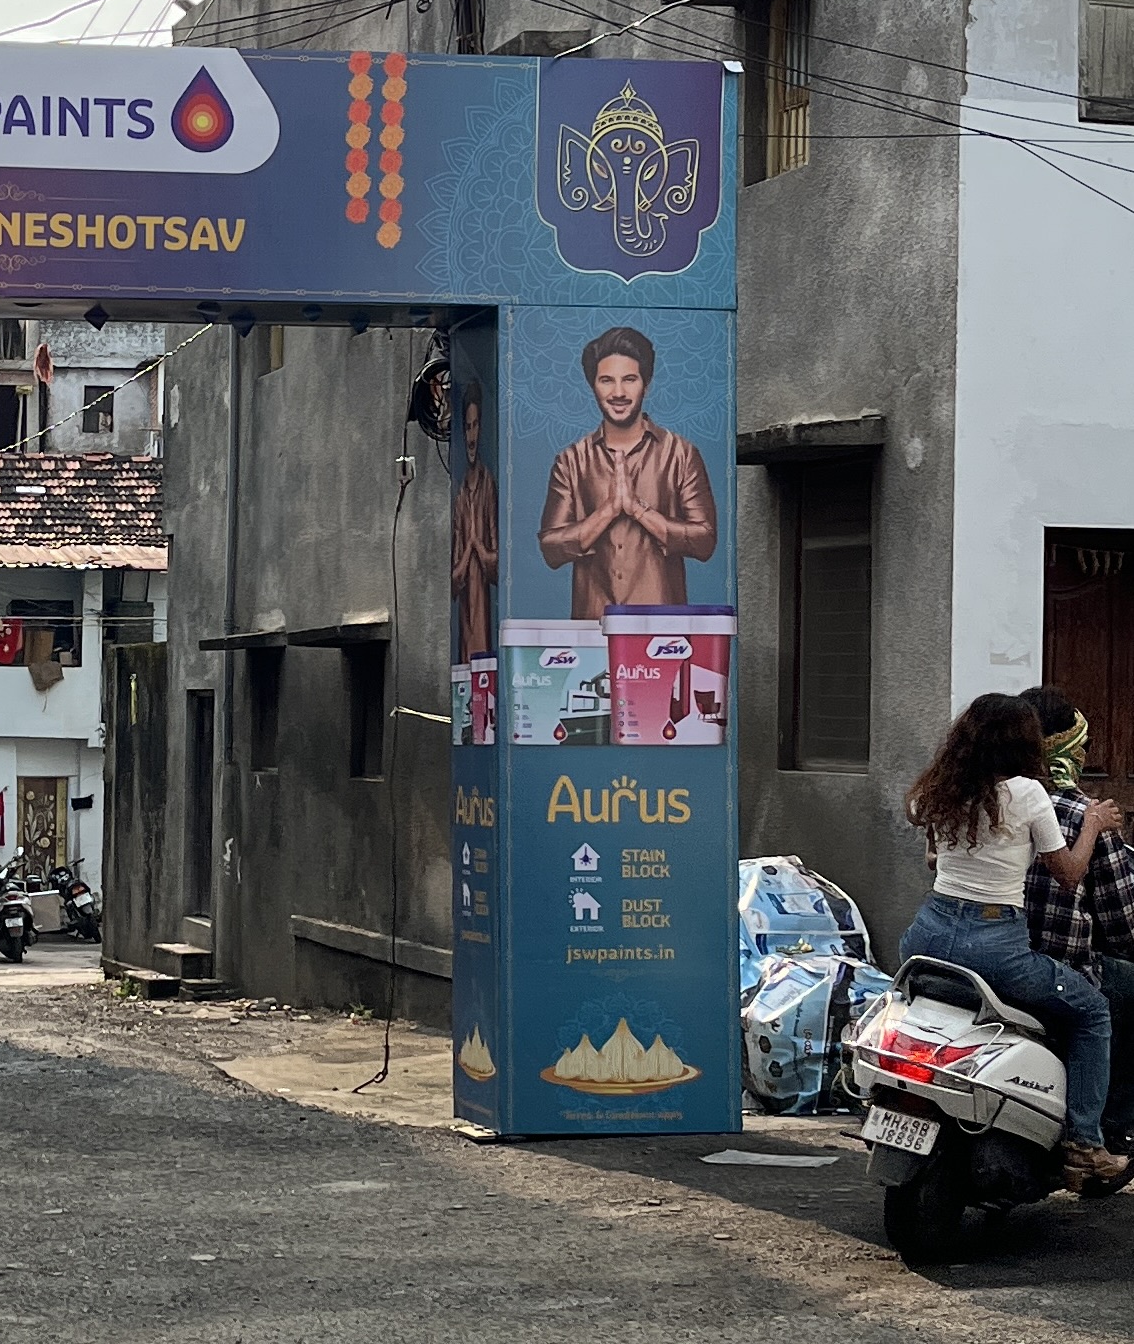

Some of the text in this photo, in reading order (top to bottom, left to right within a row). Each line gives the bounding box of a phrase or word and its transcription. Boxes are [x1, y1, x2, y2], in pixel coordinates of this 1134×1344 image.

[653, 644, 689, 656] JSW
[544, 656, 577, 667] JSW
[616, 663, 661, 680] Aurus
[511, 673, 552, 688] Aurus
[455, 785, 495, 827] Aurus
[547, 775, 691, 824] Aurus
[622, 849, 666, 862] STAIN
[621, 865, 671, 878] BLOCK
[622, 899, 662, 912] DUST
[622, 915, 671, 928] BLOCK
[566, 944, 675, 964] jswpaints.in
